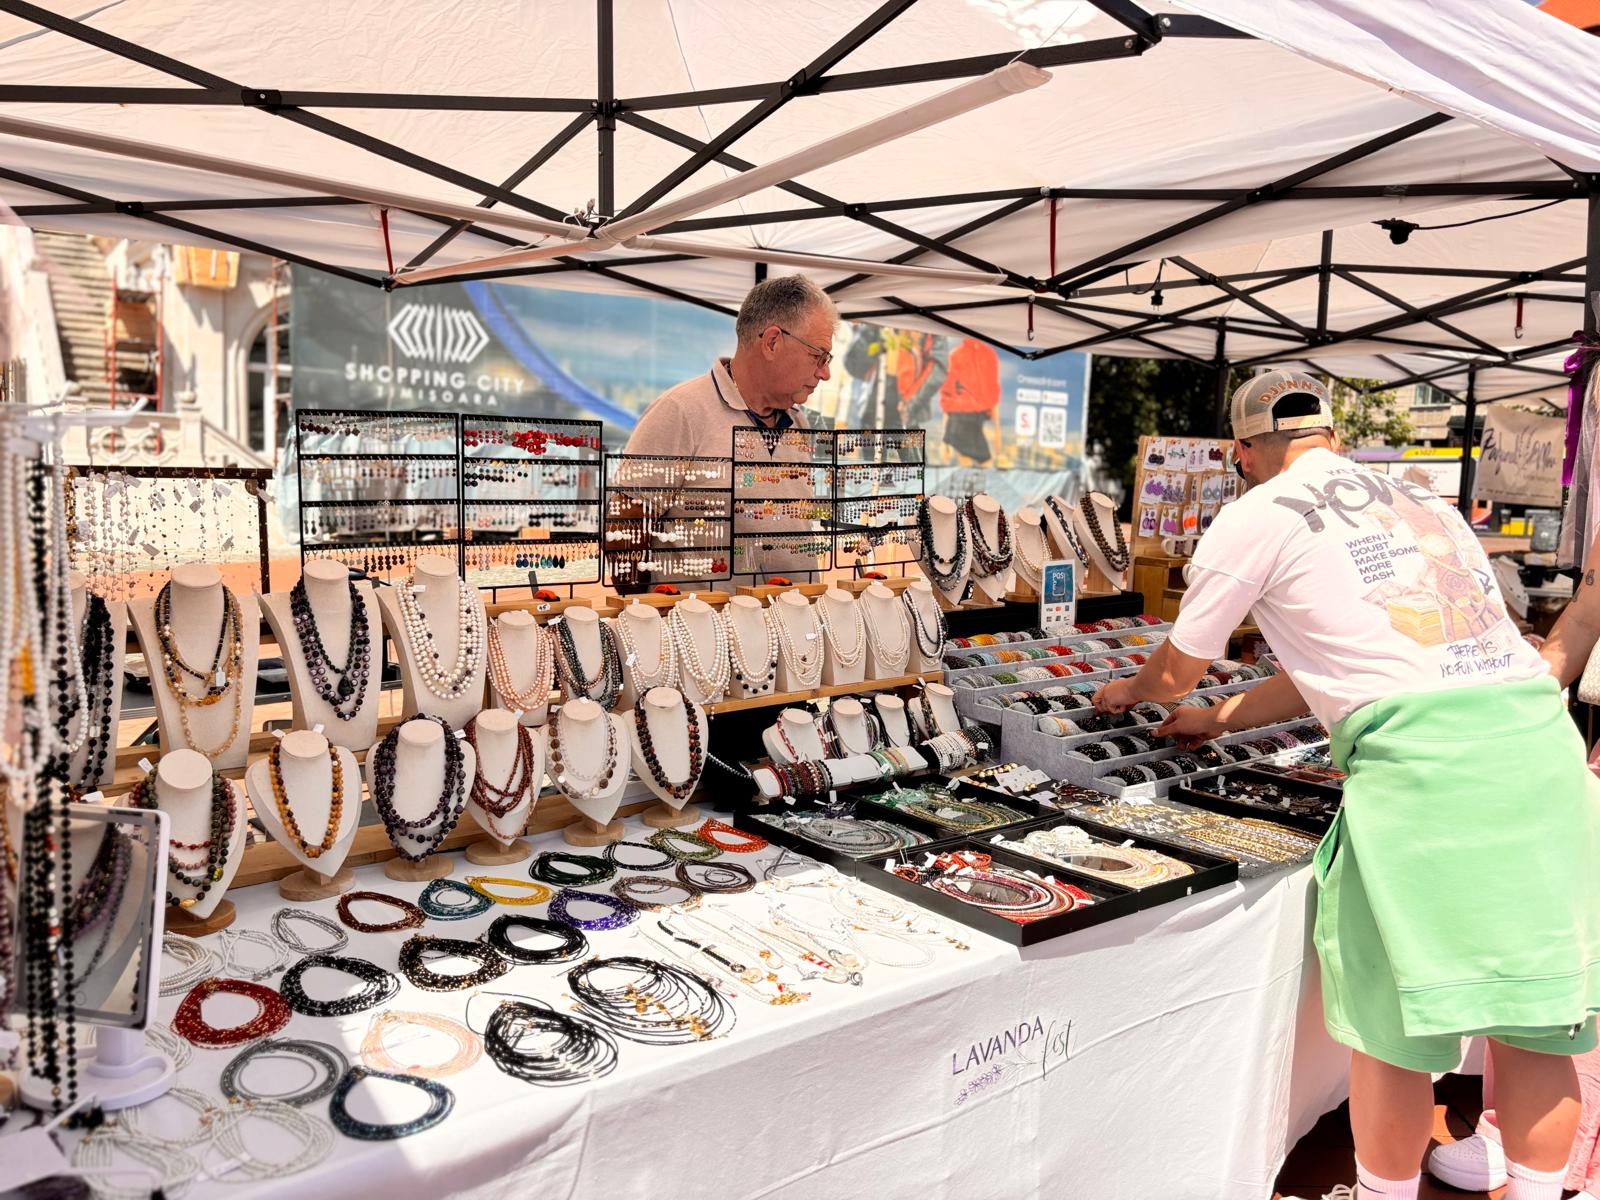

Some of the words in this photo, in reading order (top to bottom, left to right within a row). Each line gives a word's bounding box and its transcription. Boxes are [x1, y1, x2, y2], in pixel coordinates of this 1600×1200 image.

[344, 362, 467, 390] SHOPPING
[476, 374, 526, 394] CITY
[1345, 533, 1381, 549] WHEN
[1350, 541, 1390, 558] DOUBT
[1354, 550, 1388, 567] MAKE
[1389, 544, 1421, 559] SOME
[1359, 560, 1393, 576] MORE
[1363, 569, 1396, 585] CASH
[1446, 644, 1480, 660] THERE
[1480, 641, 1498, 656] IS
[1474, 652, 1516, 672] WITHOUT
[952, 1015, 1044, 1075] LAVANDA
